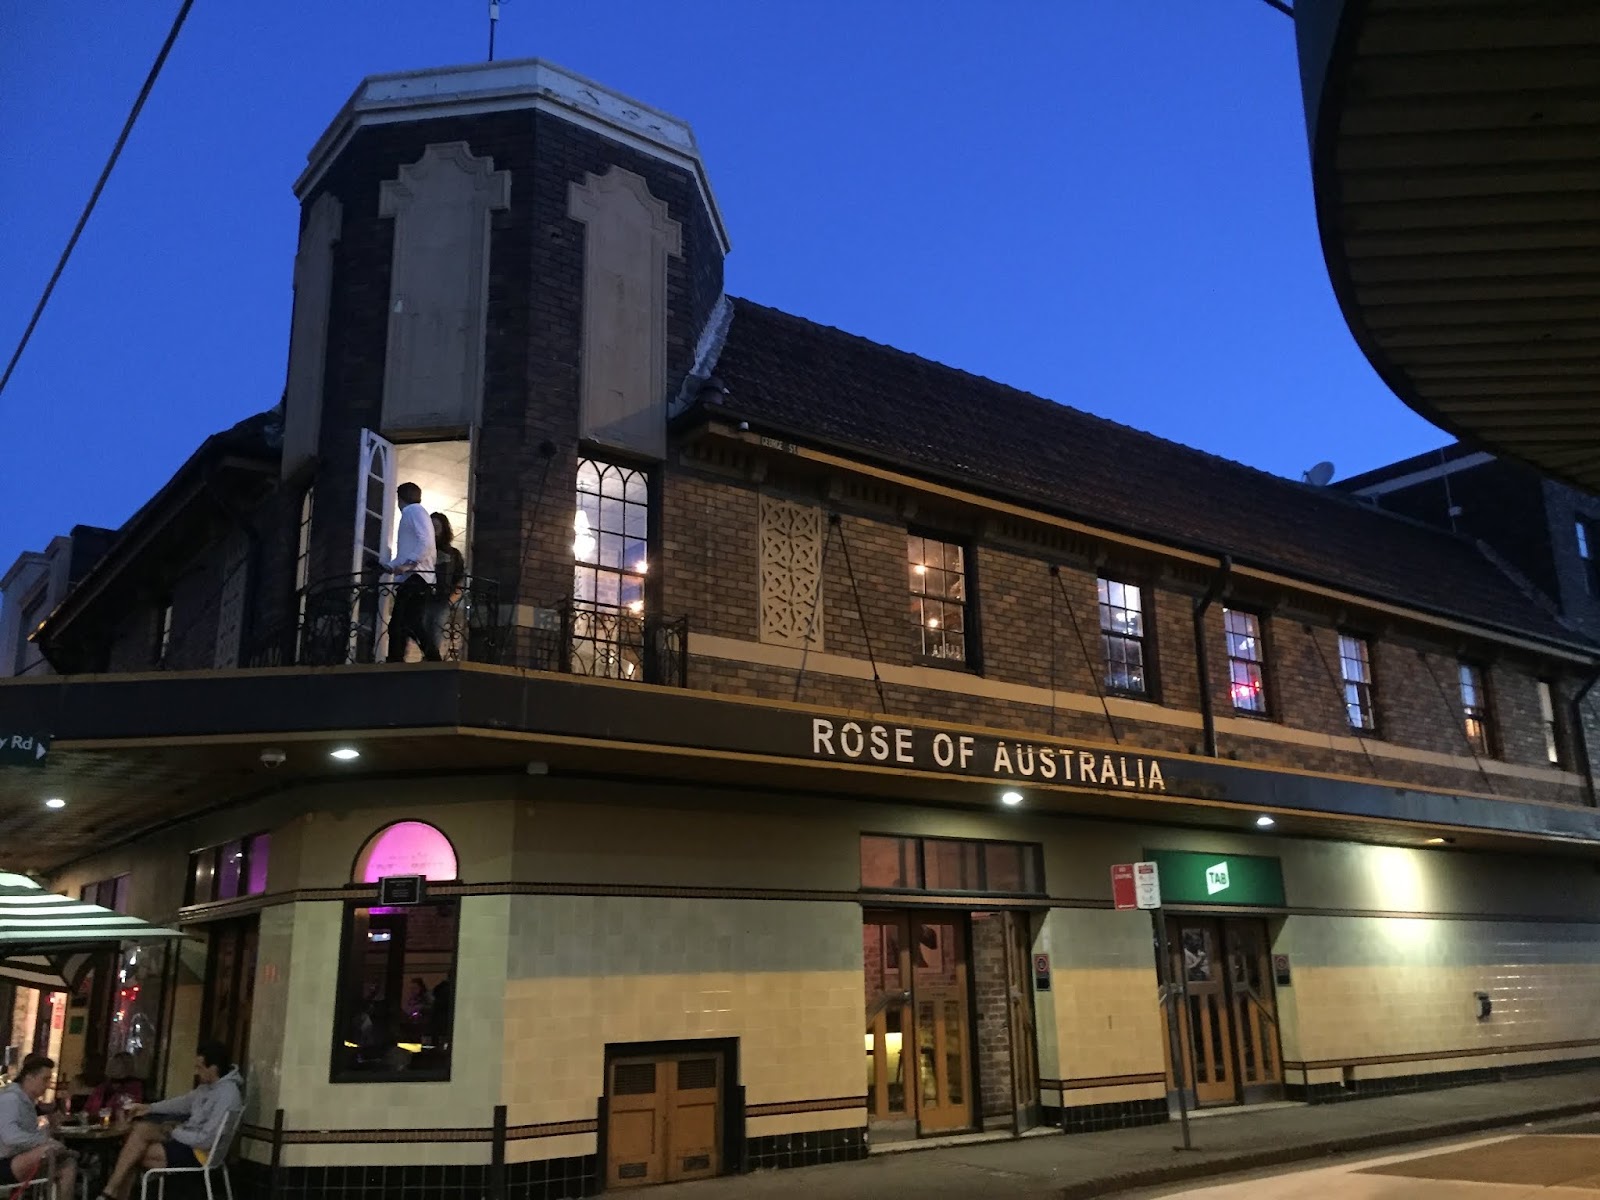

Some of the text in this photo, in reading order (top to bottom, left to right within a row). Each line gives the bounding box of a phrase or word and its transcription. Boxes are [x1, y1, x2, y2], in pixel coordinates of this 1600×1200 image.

[11, 735, 33, 750] Rd
[812, 718, 1166, 790] ROSE OF AUSTRALIA
[1208, 872, 1227, 885] TAB
